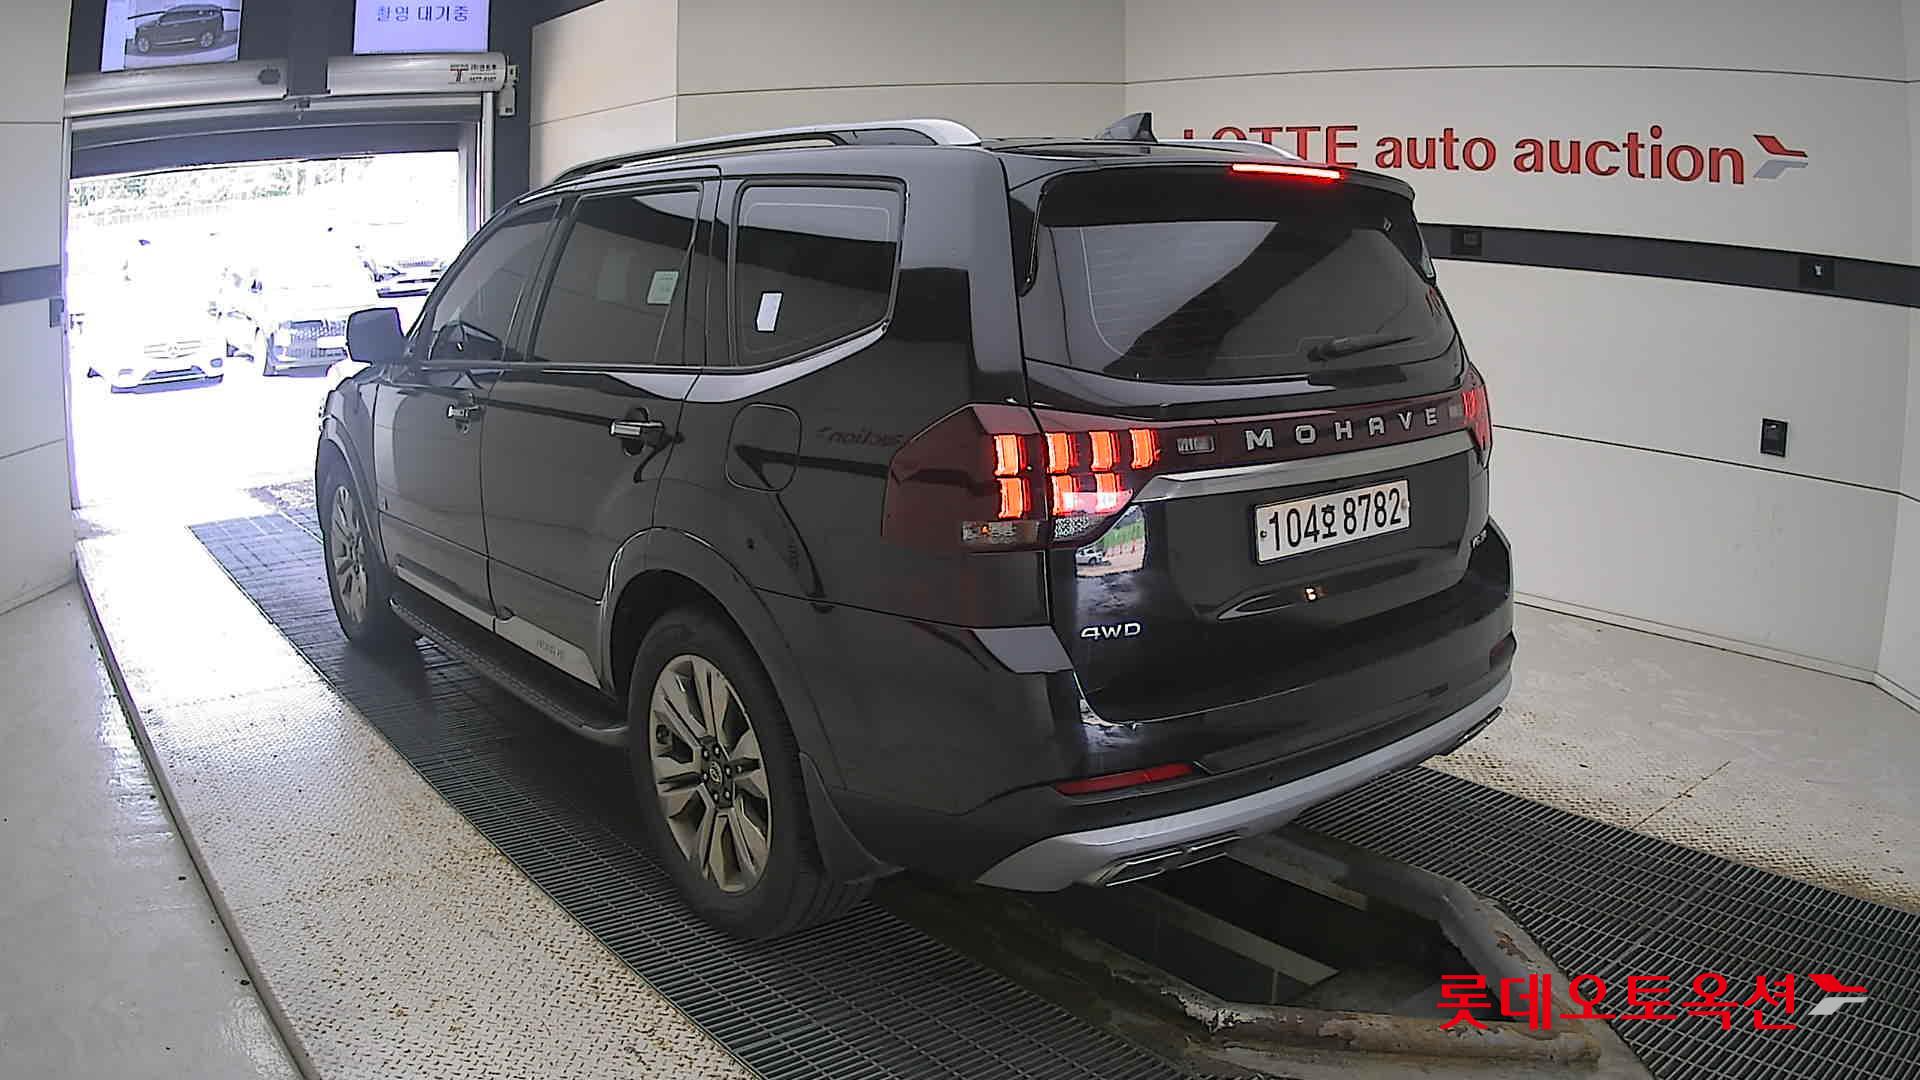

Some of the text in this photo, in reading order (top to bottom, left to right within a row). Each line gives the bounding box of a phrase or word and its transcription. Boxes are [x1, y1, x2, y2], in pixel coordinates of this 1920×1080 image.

[417, 5, 472, 22] 대기중
[1184, 125, 1745, 185] TTE auto auction
[1245, 406, 1438, 451] MOHAVE
[1268, 488, 1402, 551] 104호 8782
[1080, 622, 1141, 640] 4WD
